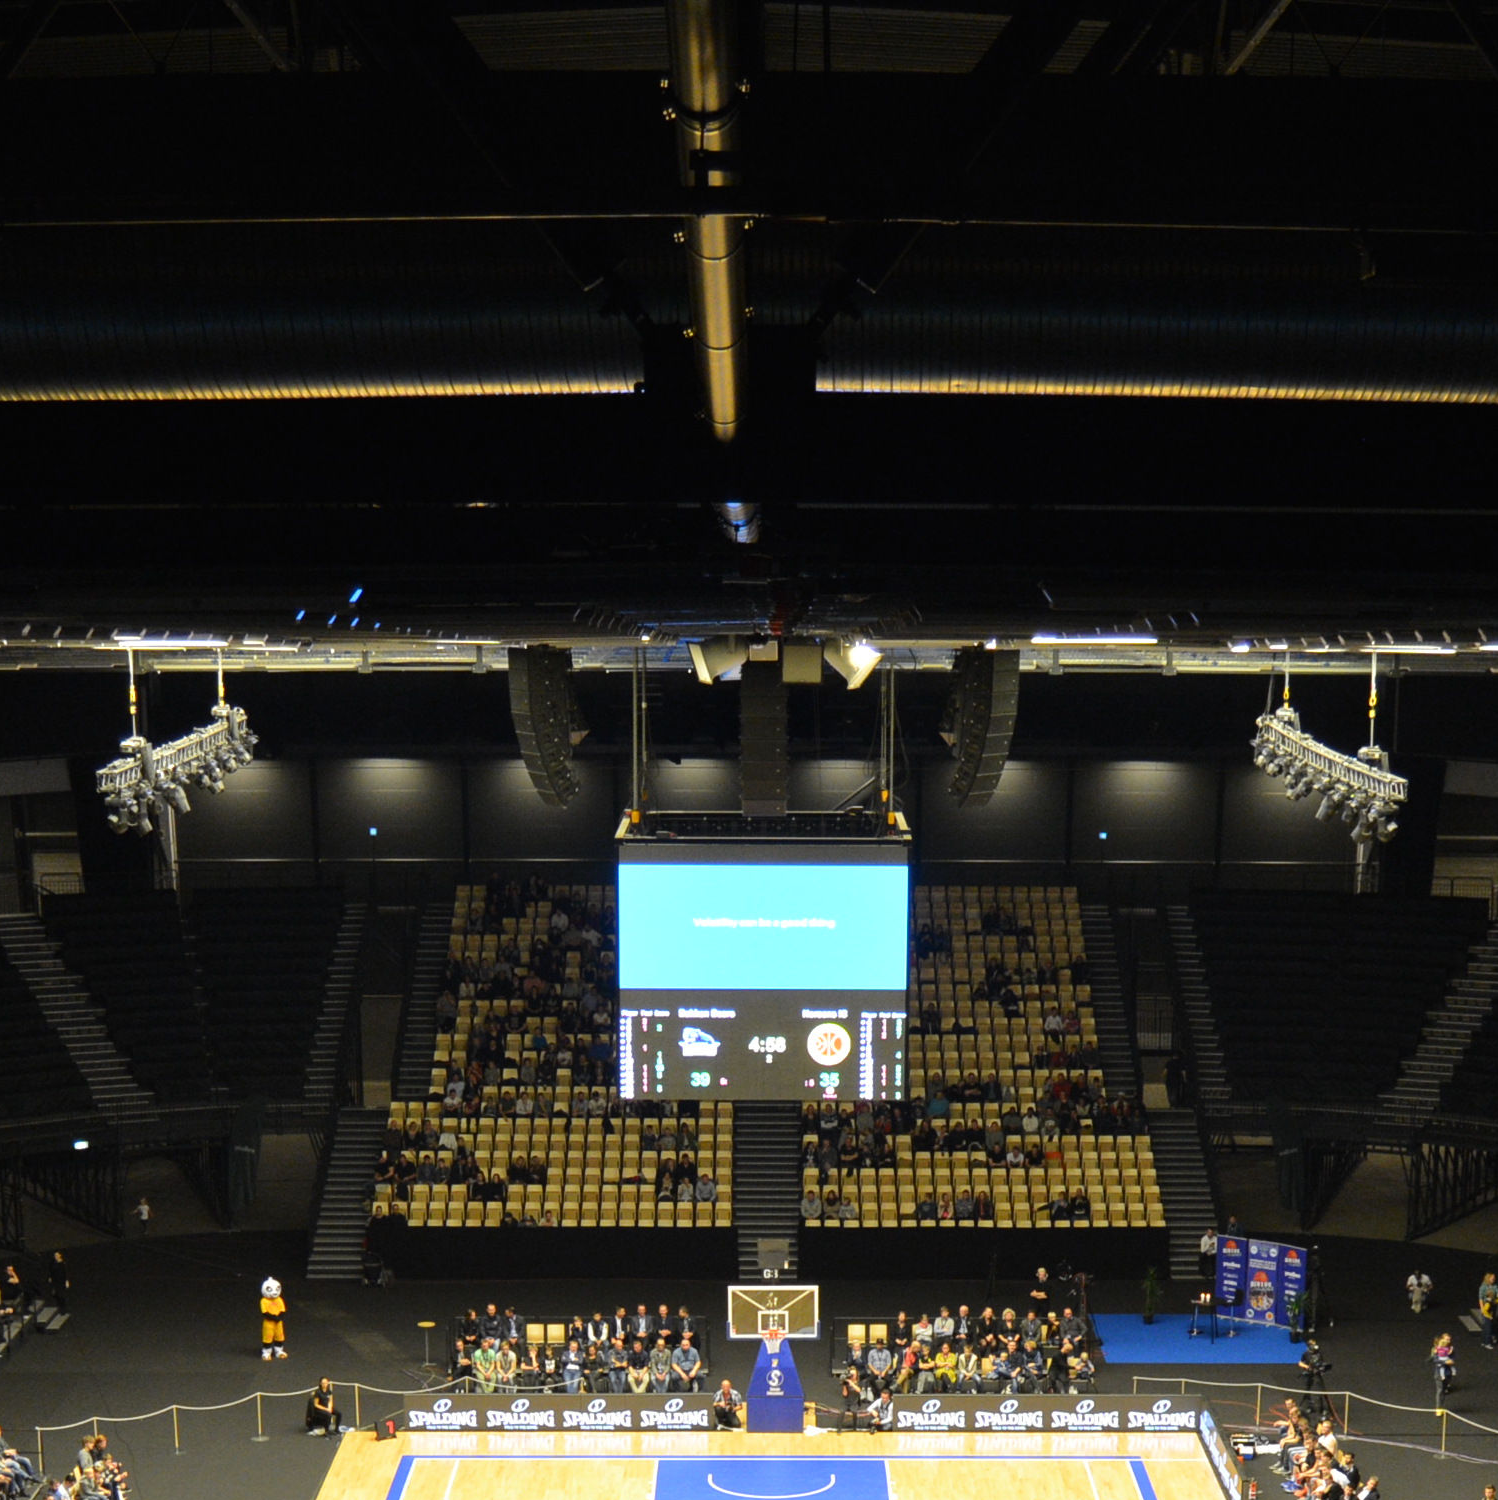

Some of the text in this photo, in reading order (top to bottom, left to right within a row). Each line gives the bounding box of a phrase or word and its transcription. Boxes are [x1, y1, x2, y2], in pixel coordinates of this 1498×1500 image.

[819, 1072, 840, 1087] 35
[409, 1409, 477, 1429] SPALDING
[486, 1409, 555, 1429] SPALDING
[563, 1409, 632, 1429] SPALDING
[640, 1409, 708, 1429] SPALDING
[897, 1409, 966, 1429] SPALDING
[975, 1409, 1043, 1429] SPALDING
[1051, 1409, 1120, 1429] SPALDING
[1128, 1409, 1196, 1429] SPALDING
